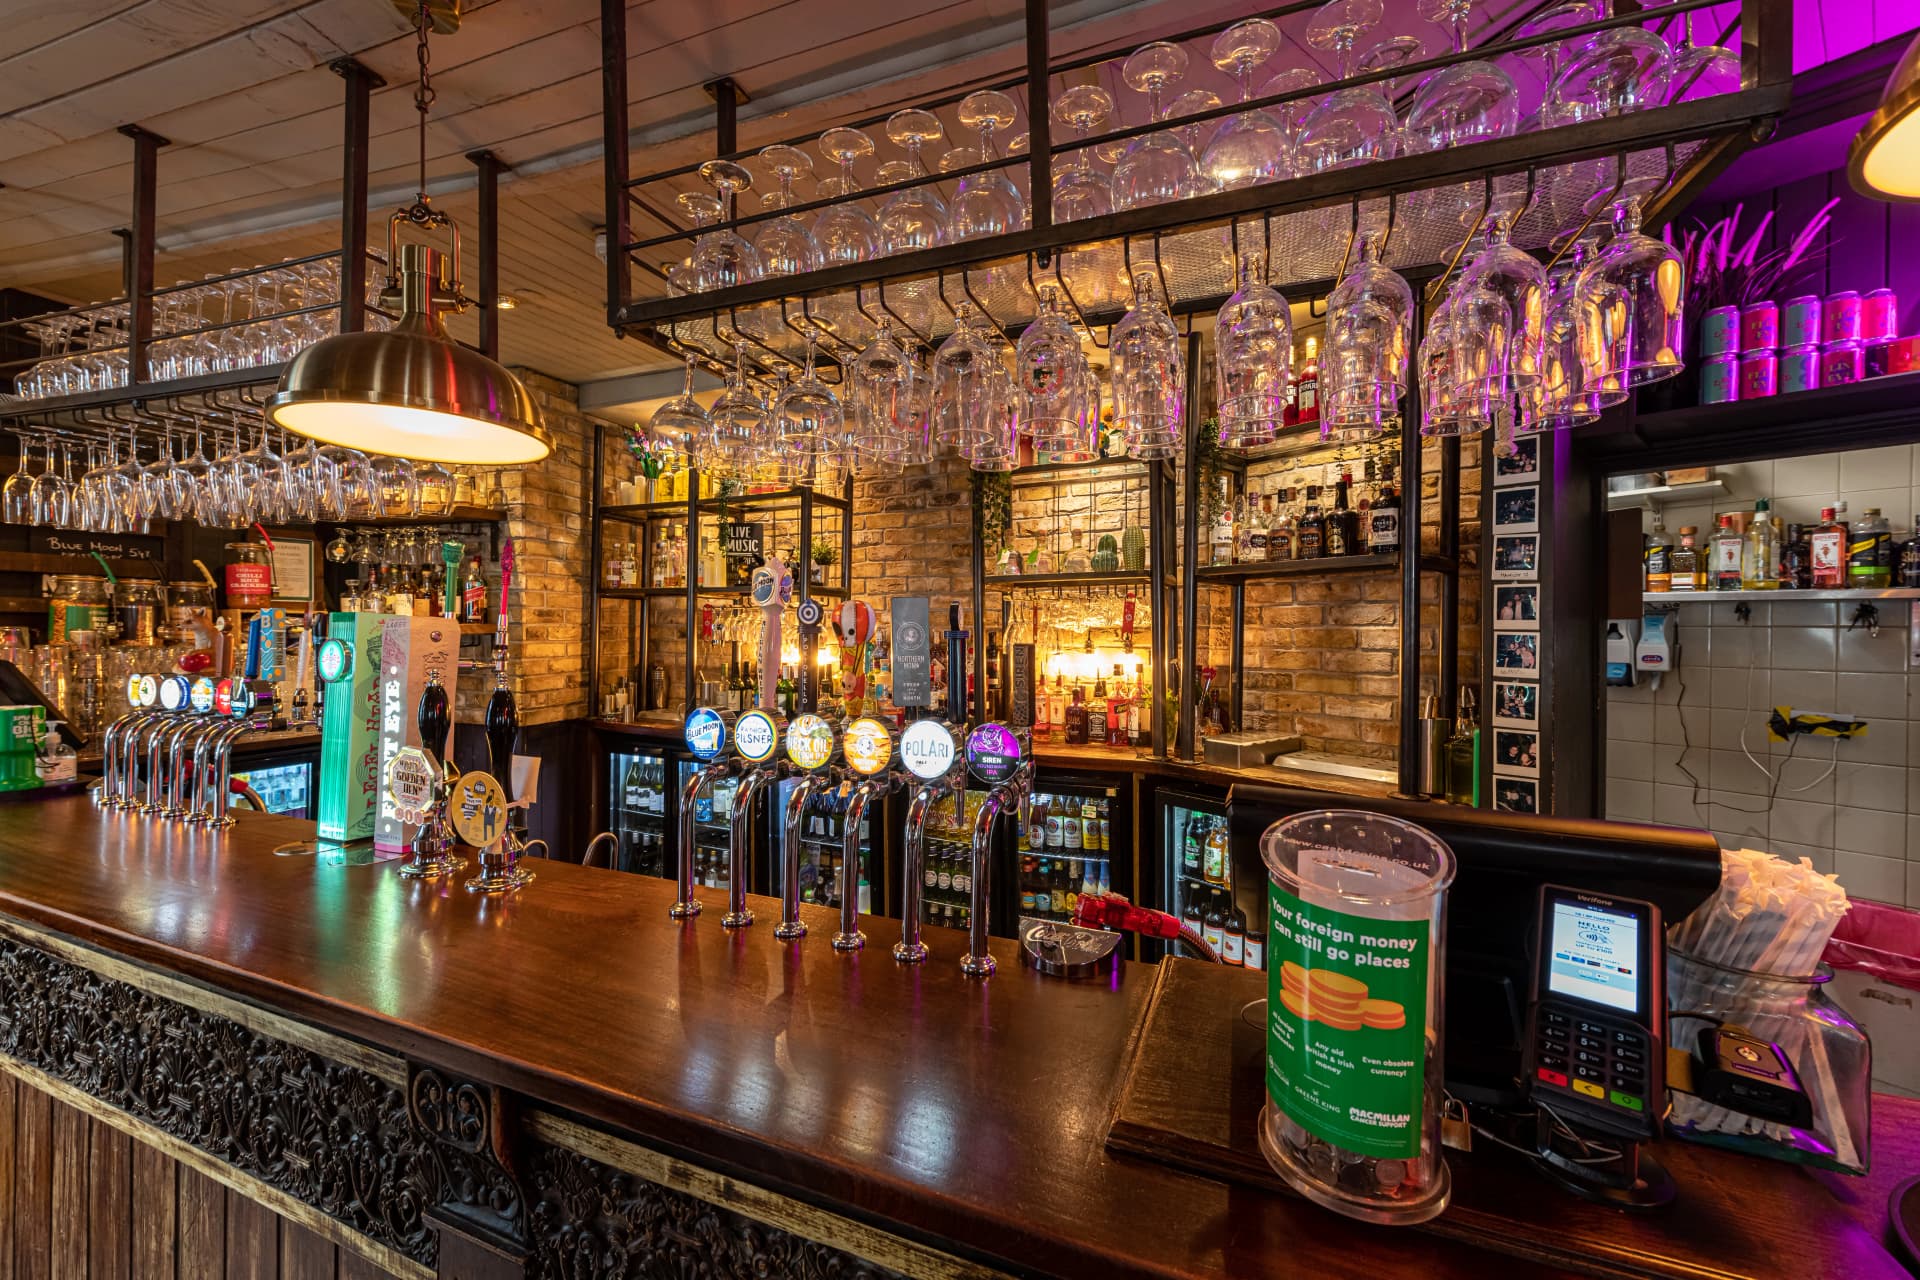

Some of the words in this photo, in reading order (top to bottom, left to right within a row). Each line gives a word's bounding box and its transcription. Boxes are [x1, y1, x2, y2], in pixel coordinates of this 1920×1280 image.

[730, 526, 751, 538] LIVE
[727, 539, 759, 552] MUSIC
[1014, 645, 1026, 689] SIREN
[687, 727, 703, 740] BLUE
[702, 722, 720, 734] MOON
[736, 733, 773, 743] PILSNER
[813, 738, 827, 753] OIL
[905, 739, 949, 758] POLARI
[982, 756, 1002, 764] SIREN
[1577, 894, 1613, 906] Verifone
[1272, 897, 1293, 920] Your
[1296, 912, 1354, 943] foreign
[1360, 934, 1417, 952] money
[1578, 921, 1610, 931] HELLO
[1274, 919, 1292, 939] can
[1295, 932, 1322, 952] still
[1327, 946, 1350, 960] go
[1355, 951, 1410, 968] places
[1581, 1023, 1588, 1031] 2
[1581, 1038, 1588, 1046] 5
[1617, 1033, 1624, 1041] 3
[1305, 1044, 1328, 1060] British
[1315, 1041, 1329, 1052] Any
[1331, 1047, 1344, 1057] old
[1617, 1048, 1624, 1056] 6
[1362, 1056, 1381, 1065] Even
[1383, 1059, 1414, 1067] obsolete
[1580, 1052, 1587, 1060] 8
[1315, 1060, 1341, 1075] money
[1370, 1068, 1407, 1078] currency!
[1579, 1067, 1587, 1075] 0
[1616, 1063, 1624, 1071] 9
[1294, 1086, 1320, 1105] GREENE
[1321, 1101, 1341, 1113] KING
[1349, 1107, 1410, 1122] MACMILLAN
[1350, 1115, 1377, 1126] CANCER
[1378, 1120, 1408, 1128] SUPPORT
